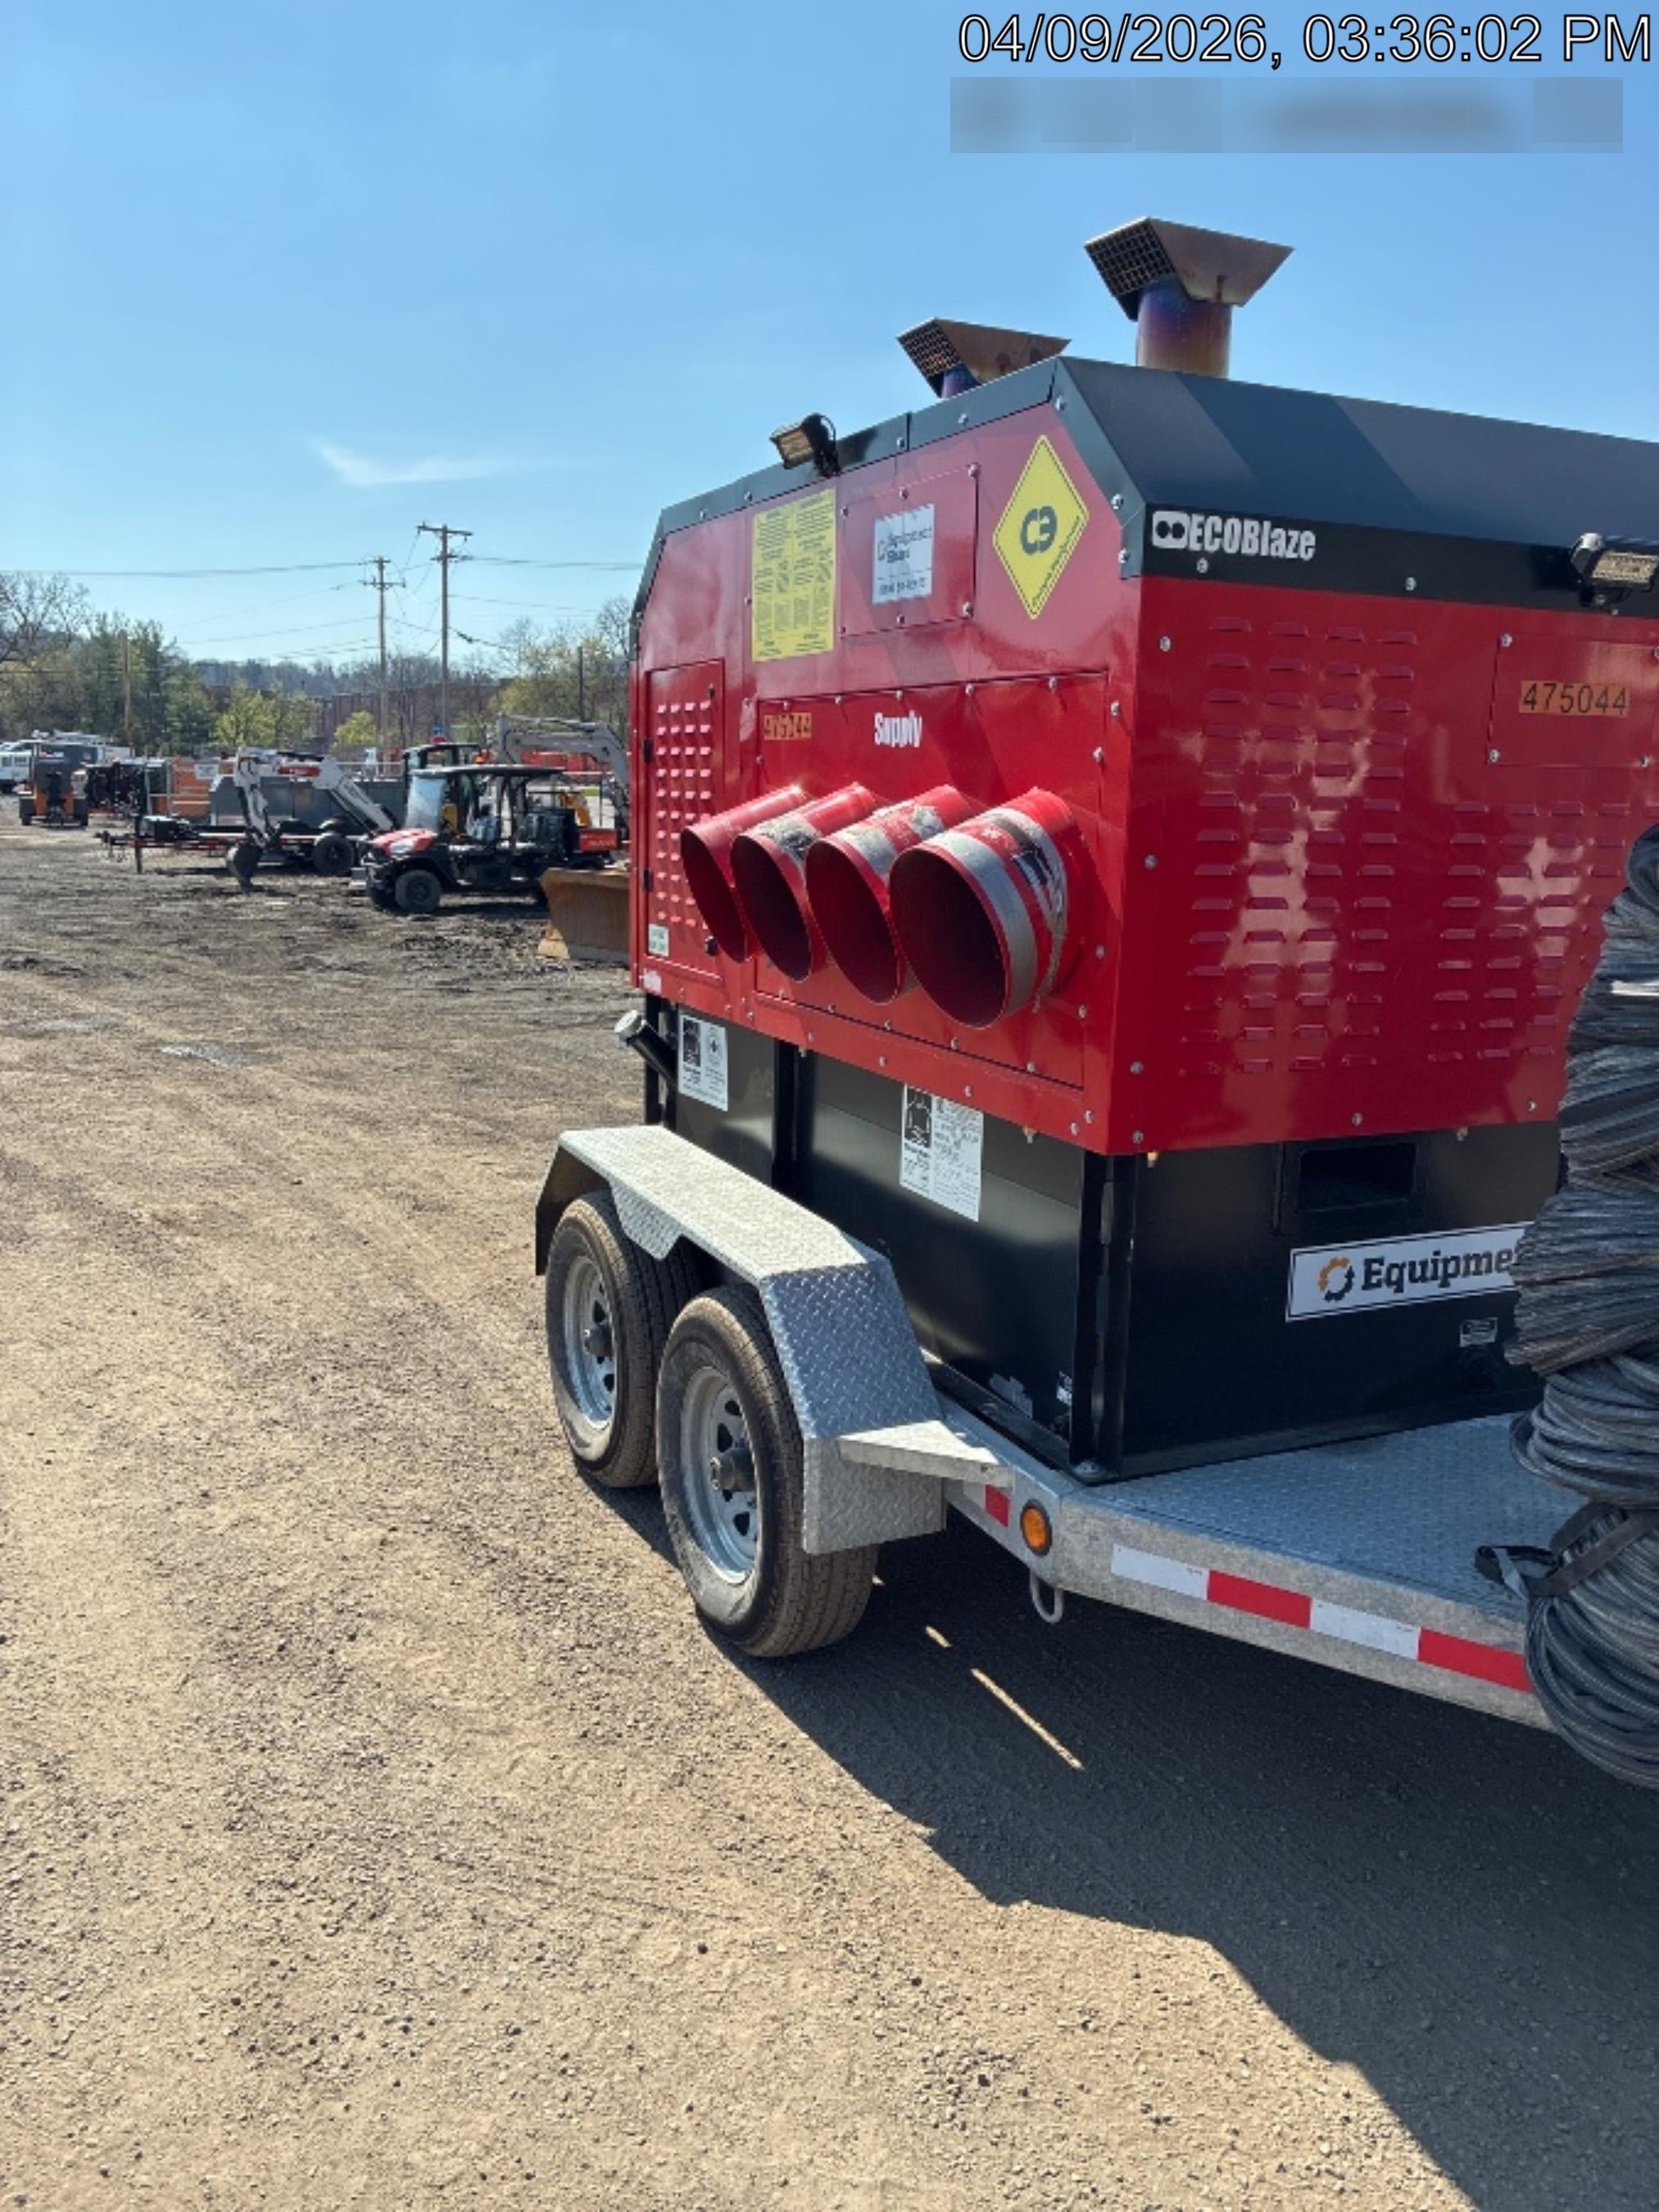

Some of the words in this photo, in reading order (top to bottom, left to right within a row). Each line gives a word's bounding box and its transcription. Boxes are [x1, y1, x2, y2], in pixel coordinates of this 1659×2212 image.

[1188, 514, 1317, 561] ECOBlaze
[1524, 683, 1626, 715] 475044
[874, 709, 923, 748] Supply
[1361, 1248, 1516, 1294] Equipme
